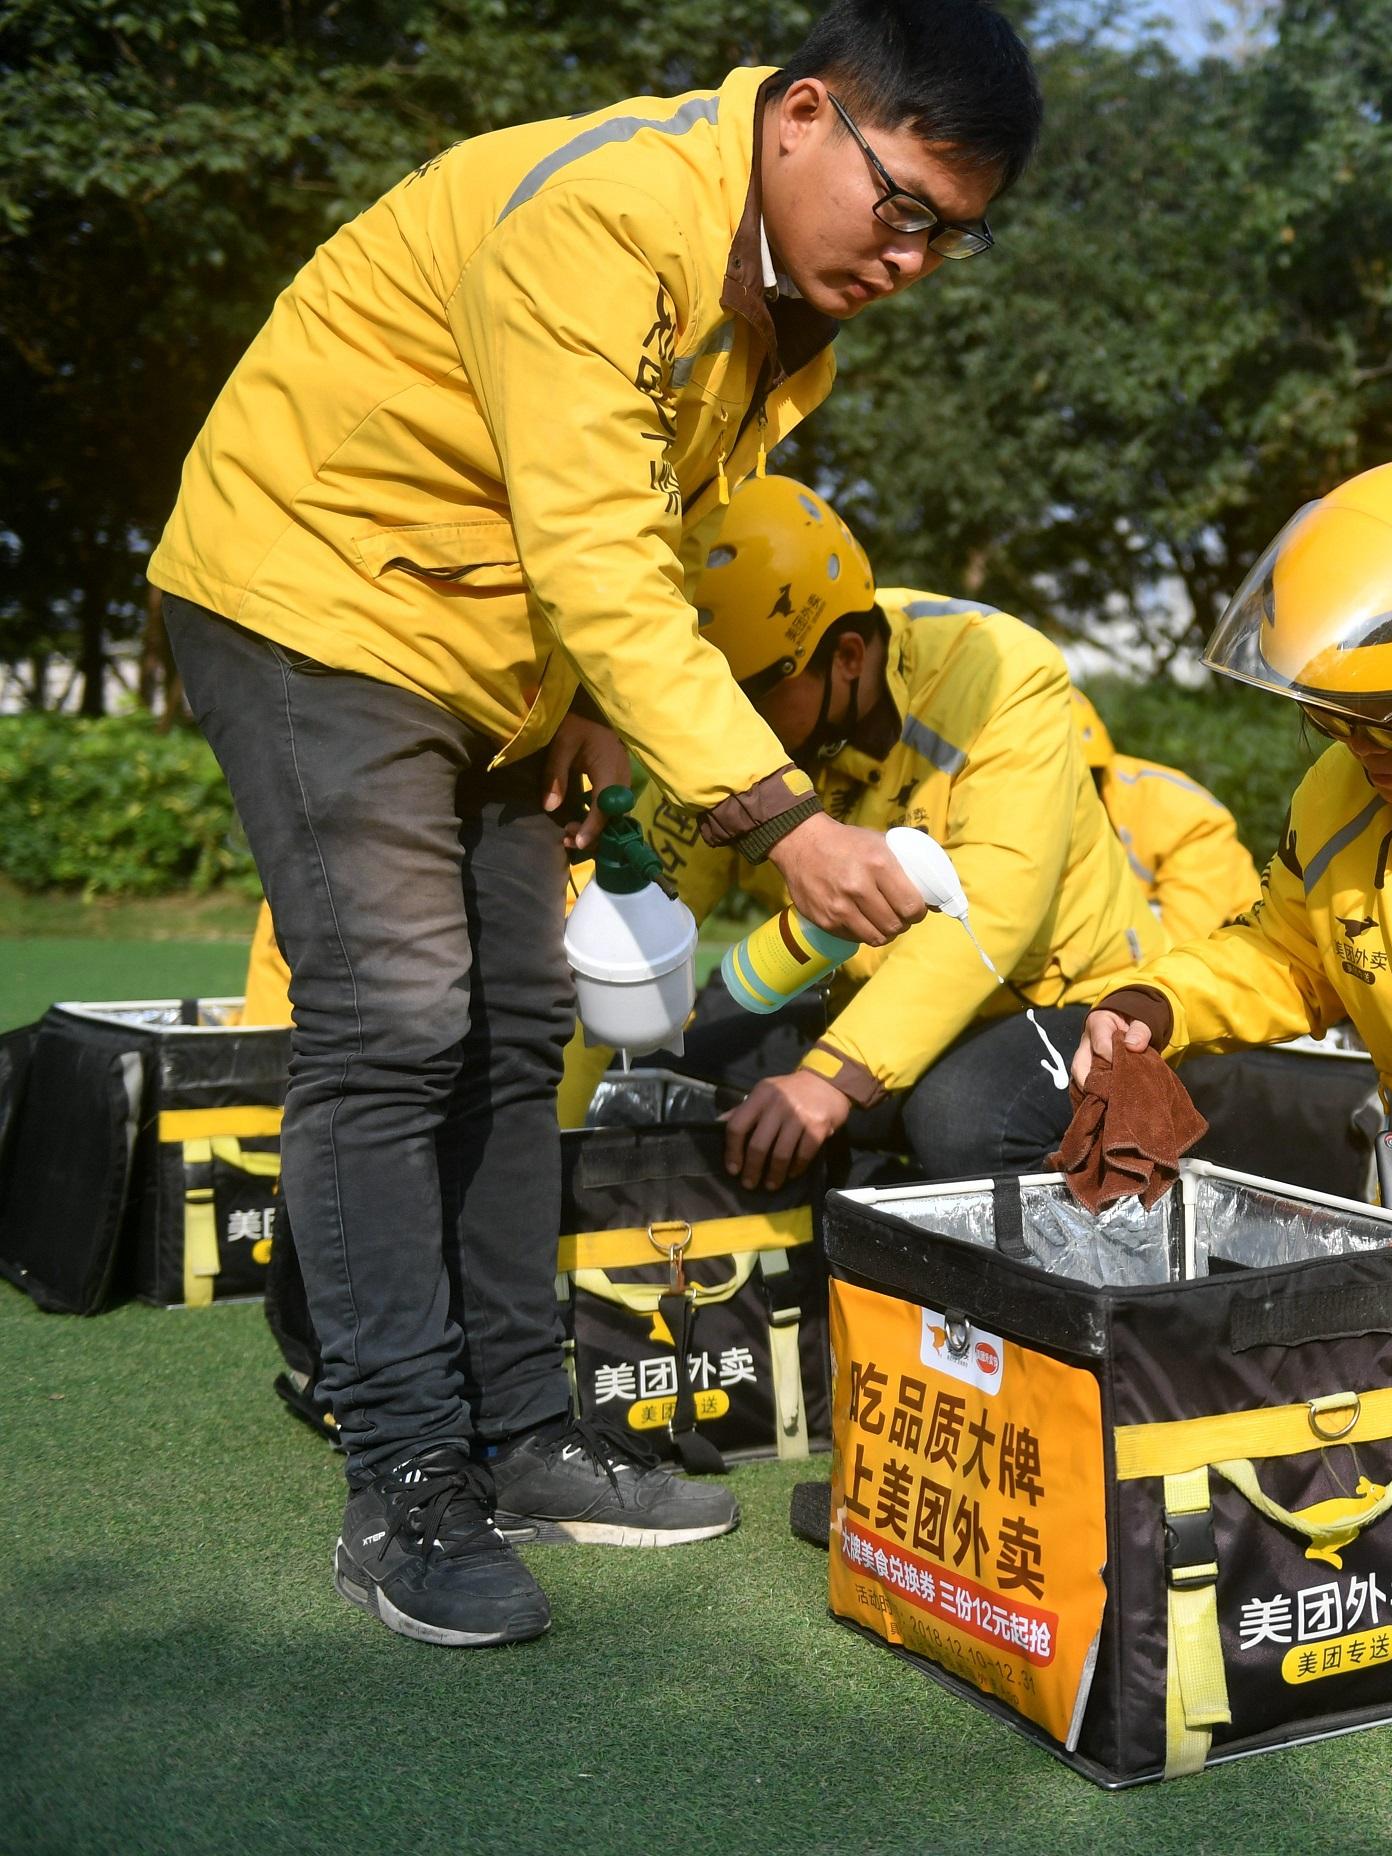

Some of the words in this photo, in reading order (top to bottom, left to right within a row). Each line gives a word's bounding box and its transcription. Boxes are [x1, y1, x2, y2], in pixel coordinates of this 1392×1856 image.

[1335, 940, 1388, 972] 美团外卖
[594, 1346, 758, 1405] 美团外卖
[641, 1396, 718, 1424] 美团送
[849, 1360, 1045, 1507] 吃品质大牌
[362, 1530, 386, 1546] XTEP
[843, 1443, 1045, 1601] 上美团外卖
[841, 1526, 937, 1603] 大牌美食兑换券
[940, 1580, 1052, 1658] 三份12元起抢
[1297, 1633, 1391, 1677] 美团专送
